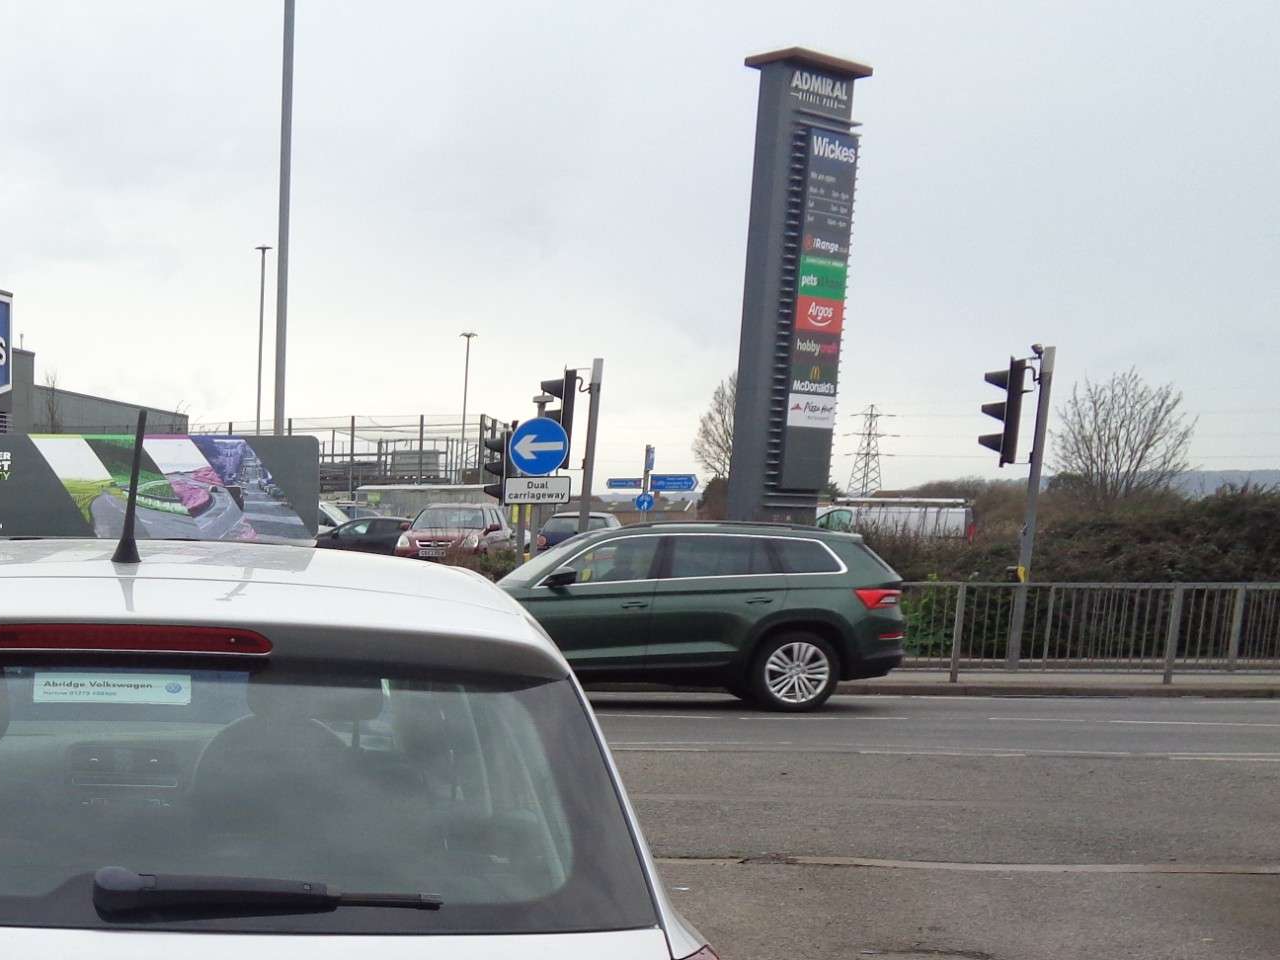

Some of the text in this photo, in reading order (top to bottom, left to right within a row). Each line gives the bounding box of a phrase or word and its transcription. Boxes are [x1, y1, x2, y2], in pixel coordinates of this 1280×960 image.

[791, 70, 847, 100] ADMIRAL
[813, 136, 856, 163] Wickes
[801, 273, 818, 287] pets
[808, 301, 833, 320] Argos
[792, 380, 835, 394] McDonald's
[527, 481, 548, 489] Dual
[508, 491, 566, 501] carriageway
[43, 680, 153, 689] Abridge Volkswagen
